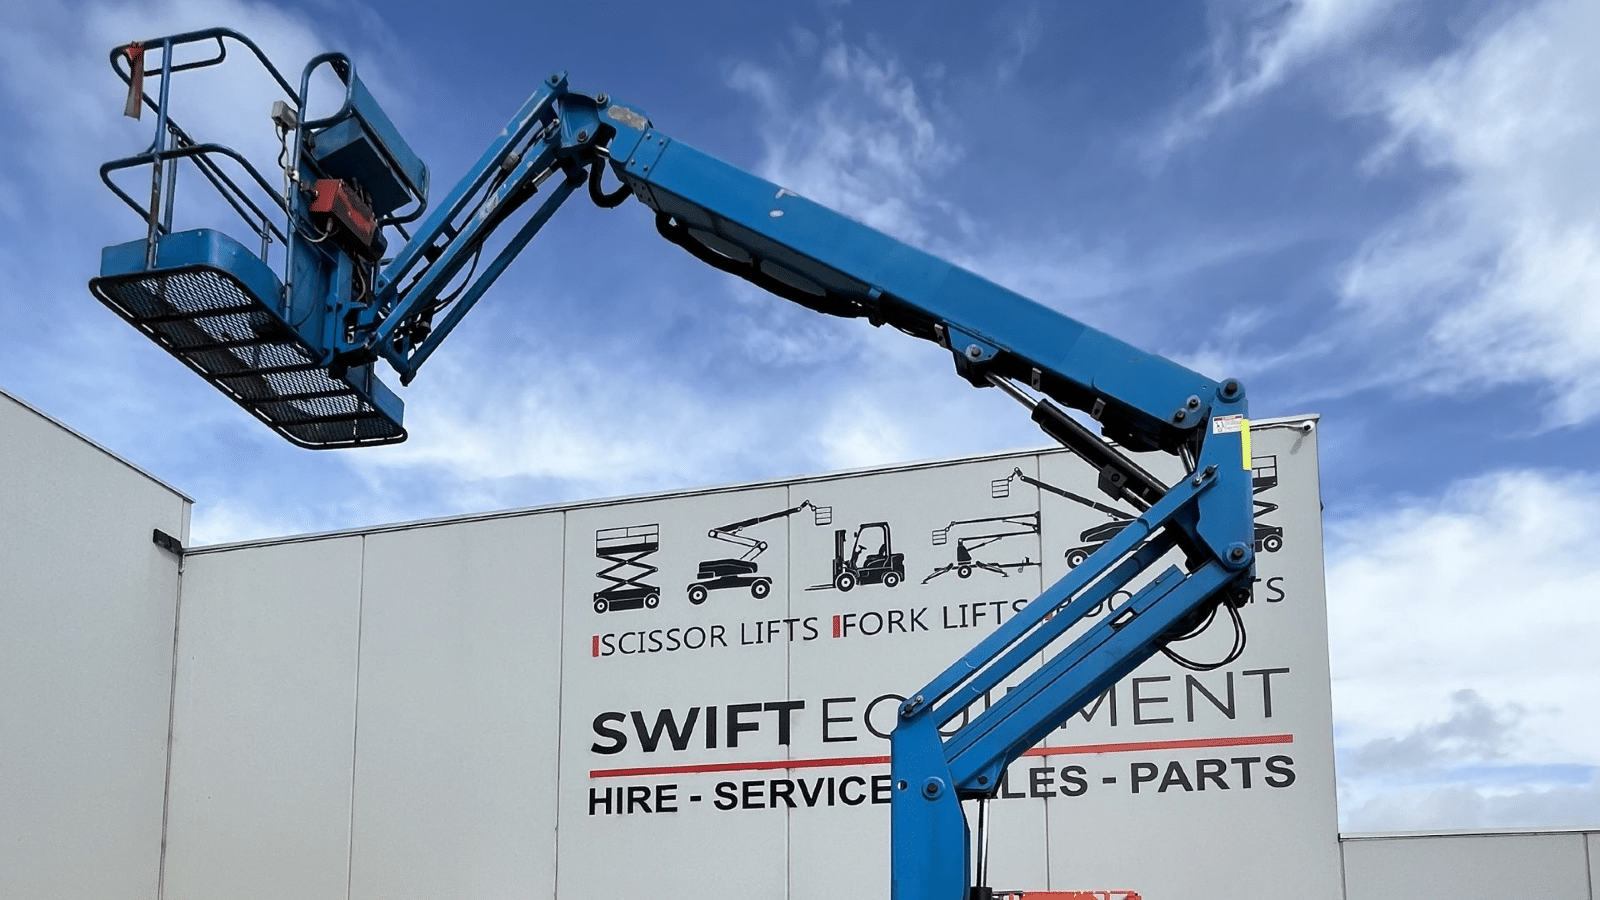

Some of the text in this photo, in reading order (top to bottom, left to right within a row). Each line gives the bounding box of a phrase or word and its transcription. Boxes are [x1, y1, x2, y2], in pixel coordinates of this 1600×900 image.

[601, 616, 819, 657] SCISSOR LIFTS
[842, 604, 929, 638] FORK
[590, 700, 806, 755] SWIFT
[588, 784, 678, 816] HIRE
[713, 775, 892, 811] SERVICE
[994, 764, 1088, 801] LES
[1130, 755, 1296, 794] PARTS
